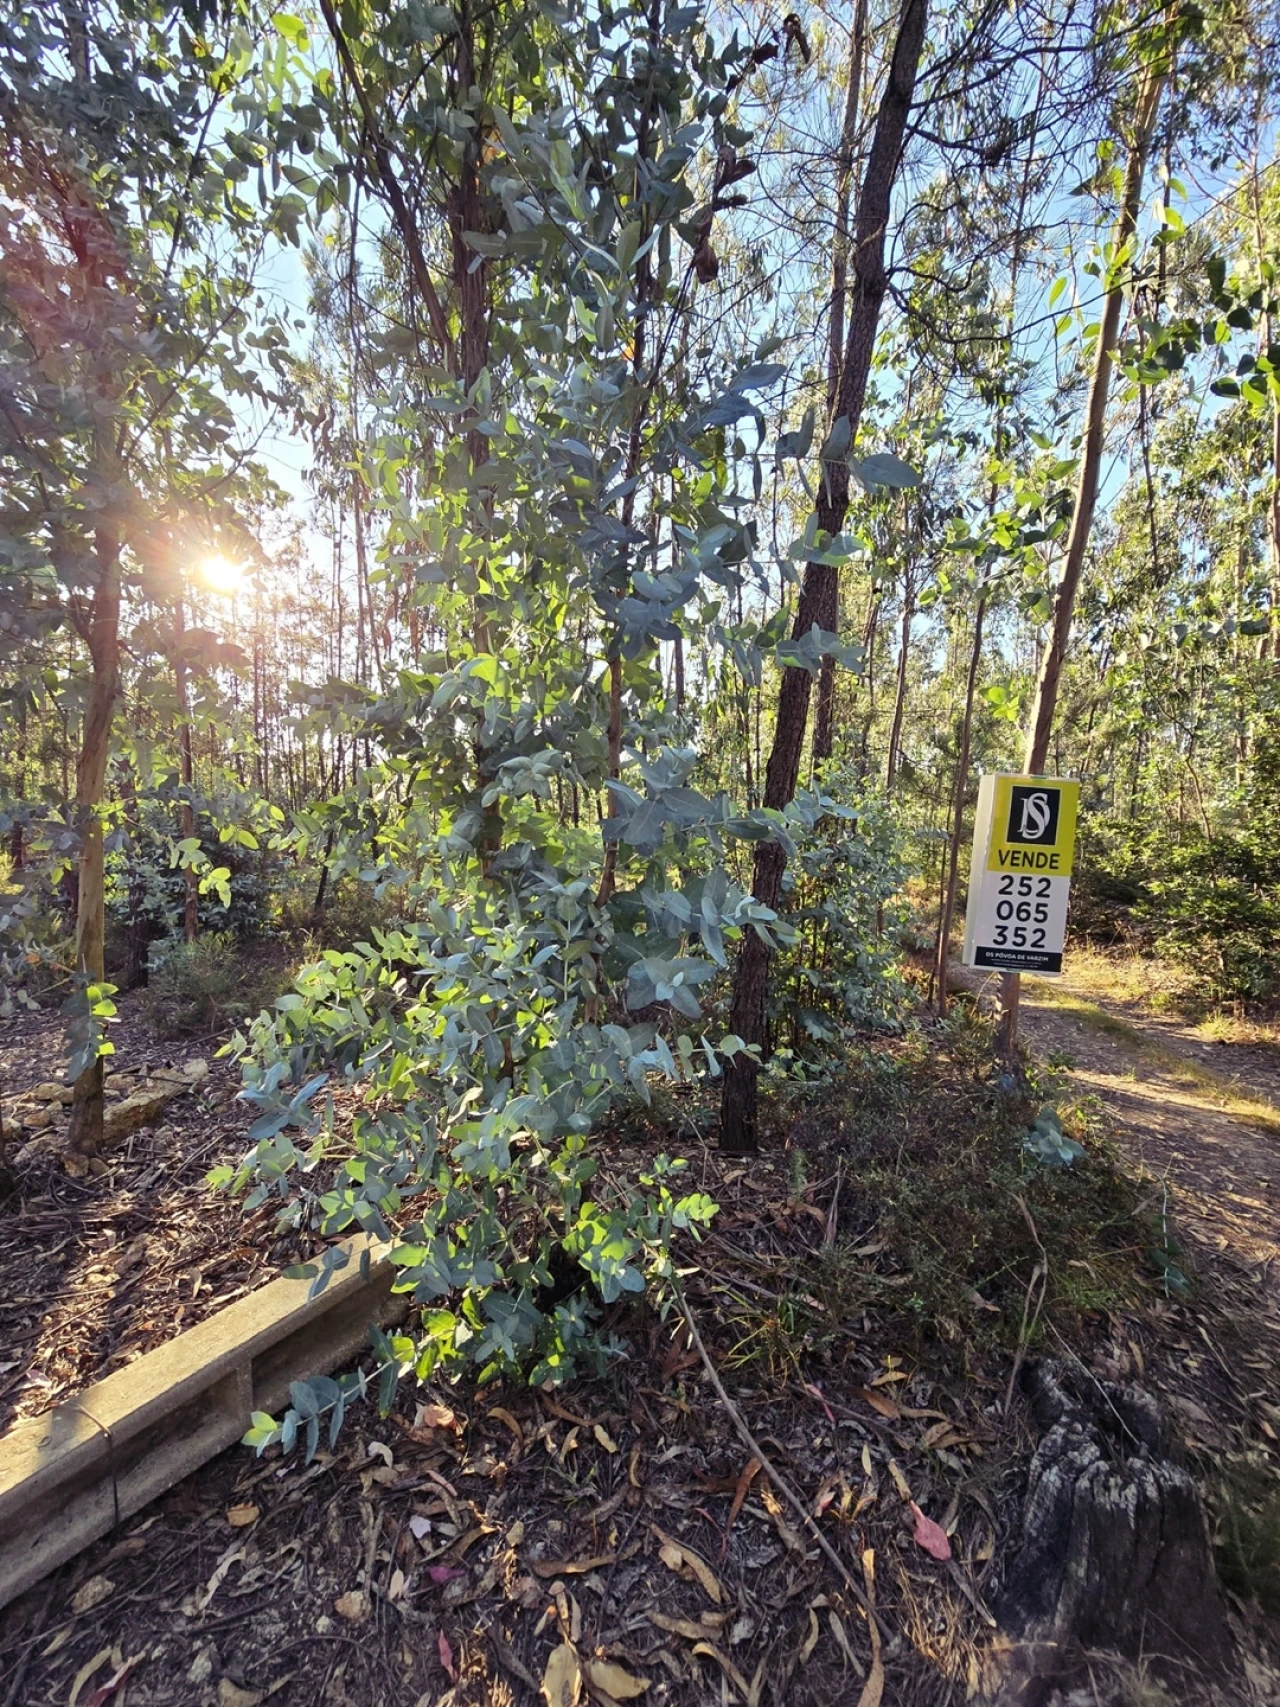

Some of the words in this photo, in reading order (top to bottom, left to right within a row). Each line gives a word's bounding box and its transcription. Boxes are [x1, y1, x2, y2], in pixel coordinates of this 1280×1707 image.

[998, 849, 1060, 869] VENDE
[998, 875, 1051, 898] 252
[996, 900, 1048, 923] 065
[993, 925, 1046, 948] 352
